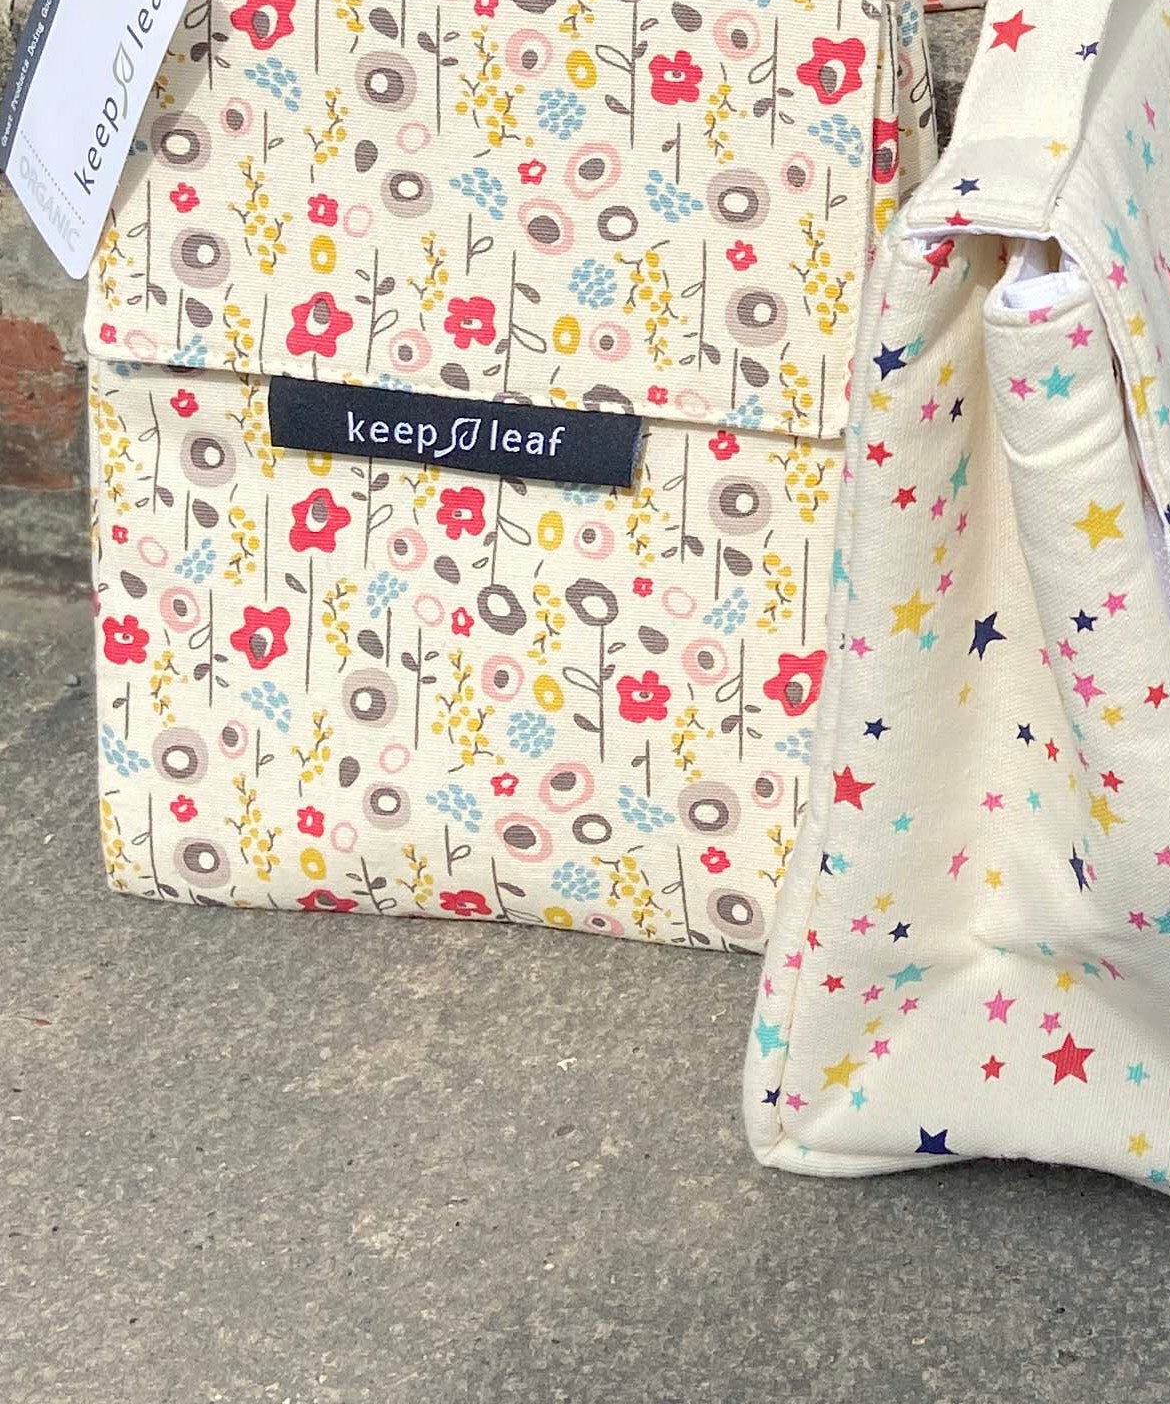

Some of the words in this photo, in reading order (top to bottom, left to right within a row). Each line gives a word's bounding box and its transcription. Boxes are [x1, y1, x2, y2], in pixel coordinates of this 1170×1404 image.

[1, 114, 14, 147] Great
[11, 60, 31, 112] Products
[28, 20, 47, 58] Doing
[74, 96, 120, 196] keep
[20, 155, 81, 253] ORGANIC
[346, 410, 438, 455] keep
[489, 419, 567, 457] leaf
